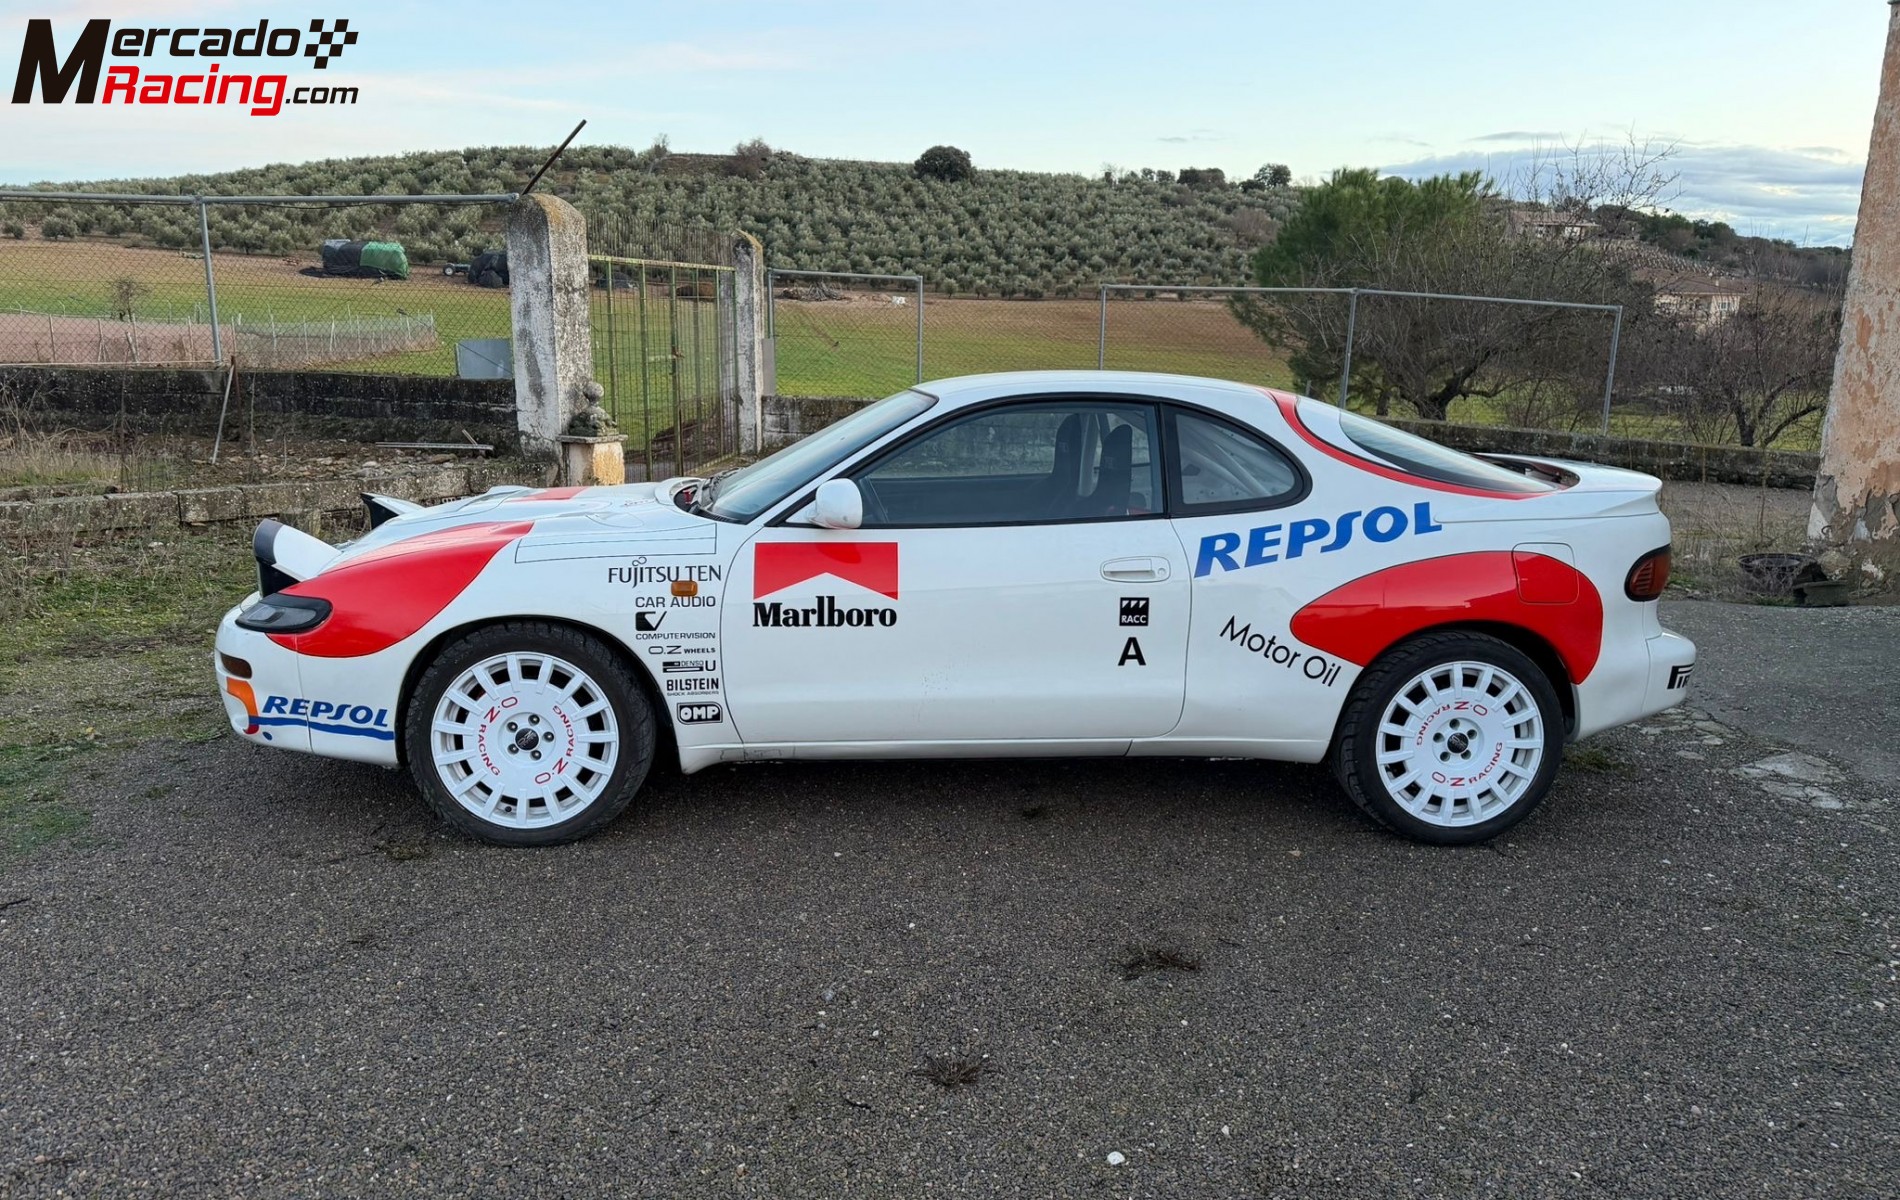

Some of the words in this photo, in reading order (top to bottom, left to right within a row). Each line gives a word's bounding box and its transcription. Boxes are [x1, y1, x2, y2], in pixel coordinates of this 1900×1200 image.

[1194, 501, 1443, 579] REPSOL
[608, 562, 680, 588] FUJITSU
[685, 565, 722, 582] TEN
[635, 597, 666, 608] CAR
[670, 596, 716, 608] AUDIO
[752, 595, 898, 628] Marlboro
[1121, 614, 1147, 624] RACC
[635, 632, 716, 640] COMPUTERVISION
[648, 645, 682, 655] O.Z
[1117, 636, 1147, 667] A
[1219, 615, 1301, 669] Motor
[1303, 655, 1342, 688] Oil
[666, 678, 719, 691] BILSTEIN
[262, 695, 388, 727] REPSOL
[680, 705, 719, 721] OMP
[1416, 703, 1450, 746] RACING
[552, 705, 575, 757] RACING
[478, 723, 501, 776] RACING
[1468, 742, 1503, 784] RACING
